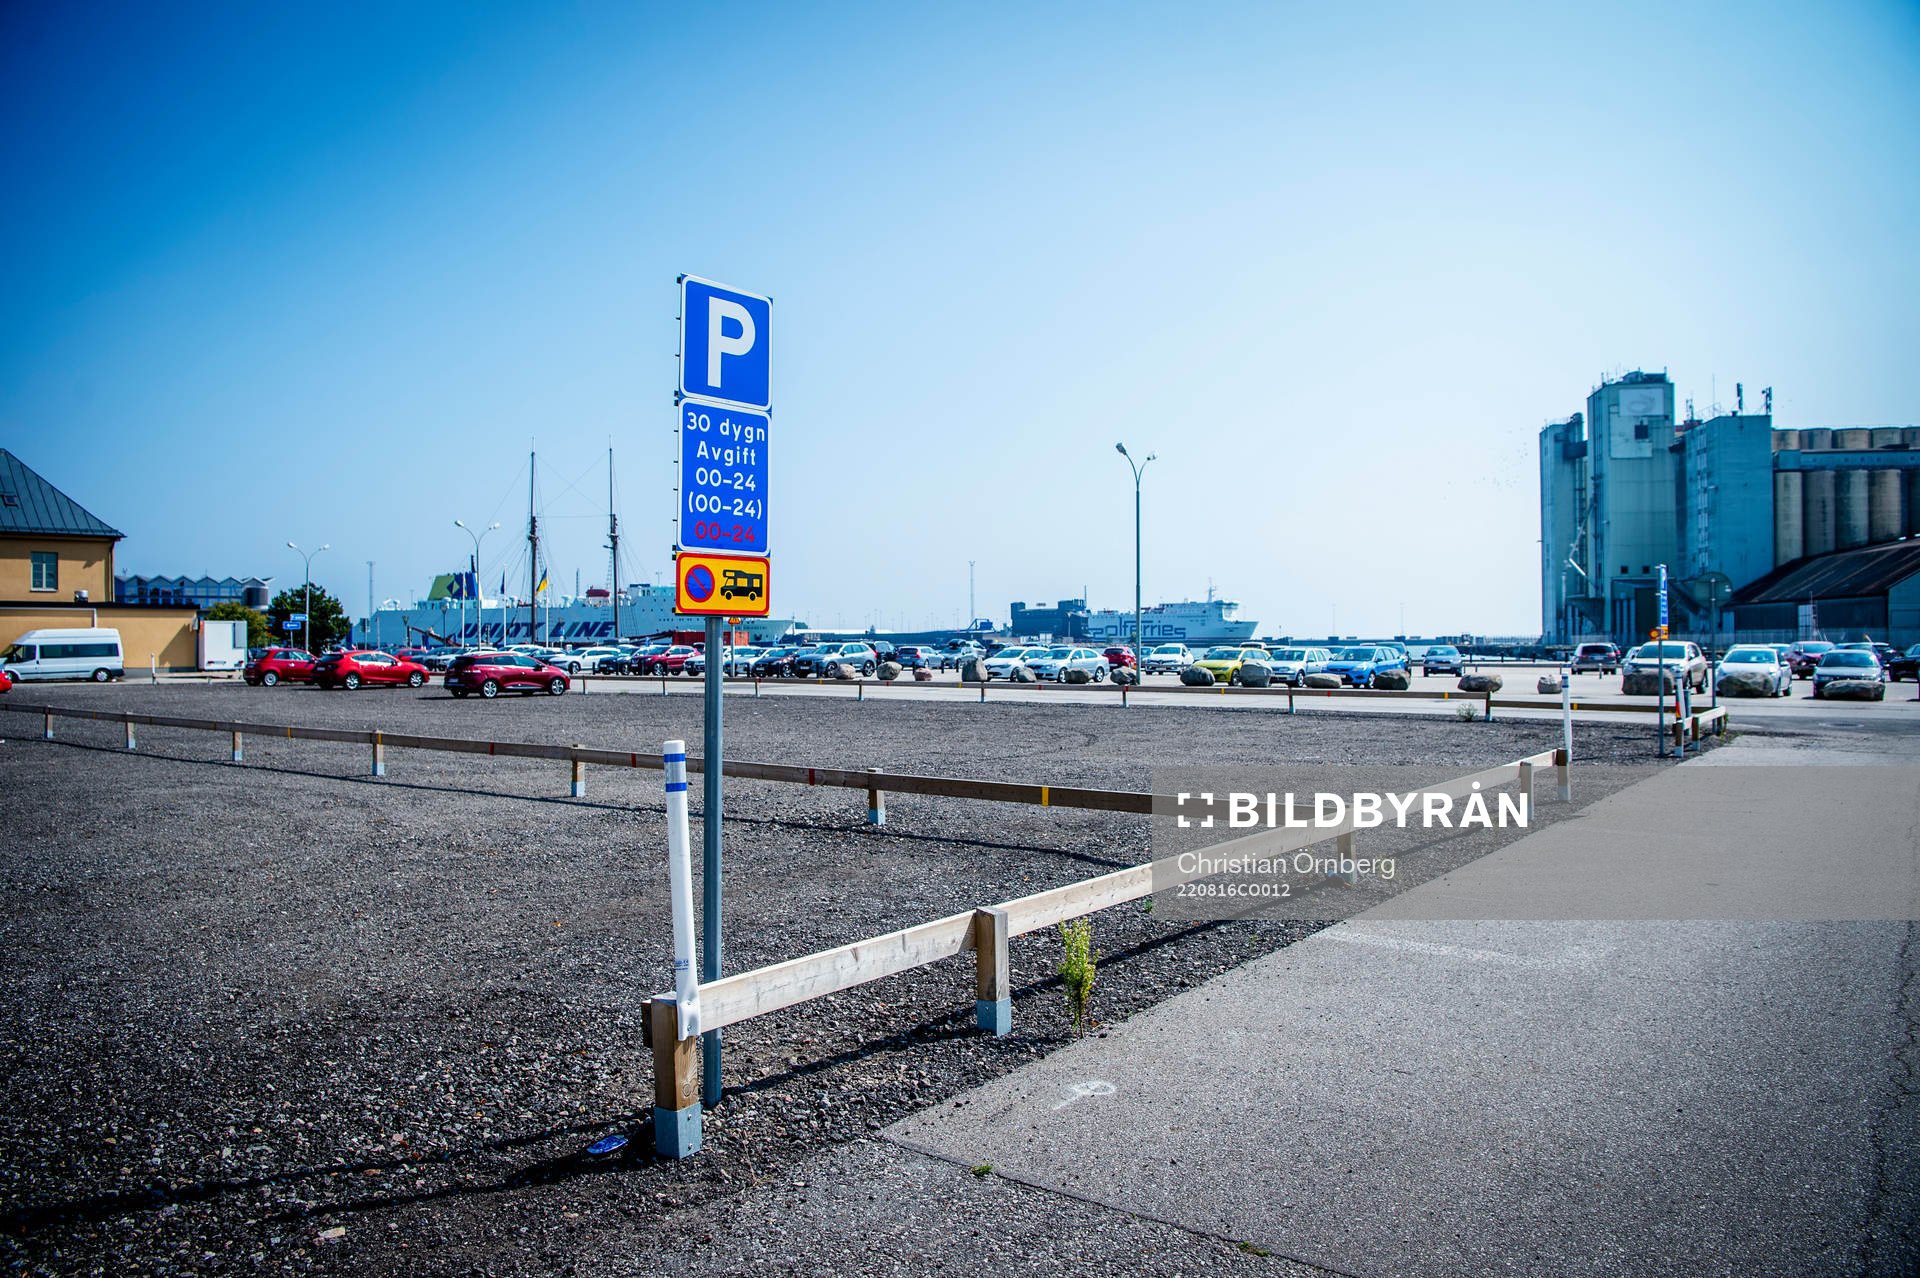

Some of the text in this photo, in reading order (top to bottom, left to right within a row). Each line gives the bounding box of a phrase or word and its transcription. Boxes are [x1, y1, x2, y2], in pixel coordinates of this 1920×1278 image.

[707, 296, 756, 388] P
[686, 411, 766, 444] 30 dygn
[696, 440, 757, 467] Avgift
[695, 467, 756, 492] 00-24
[688, 491, 763, 520] (00-24)
[694, 520, 756, 543] 00-24
[550, 622, 616, 638] LINE
